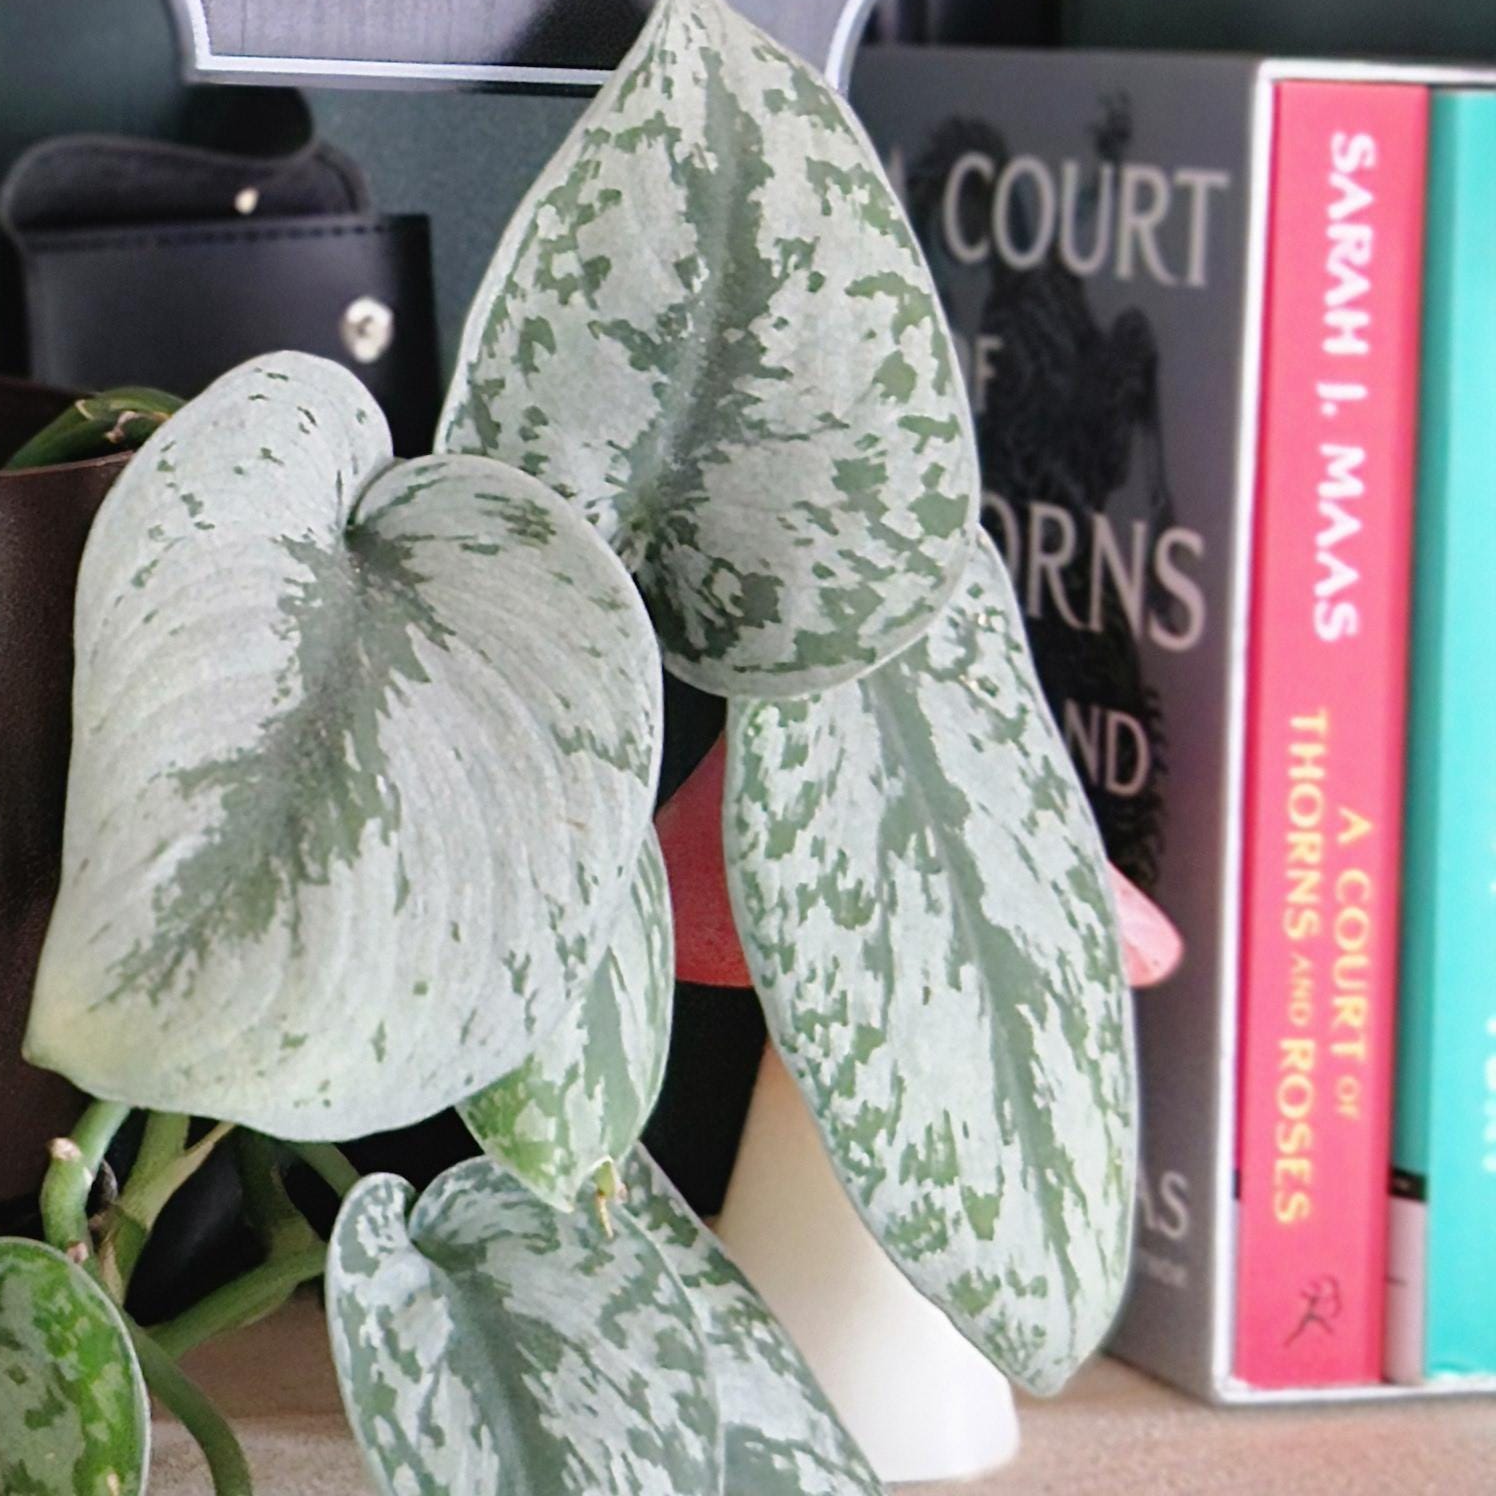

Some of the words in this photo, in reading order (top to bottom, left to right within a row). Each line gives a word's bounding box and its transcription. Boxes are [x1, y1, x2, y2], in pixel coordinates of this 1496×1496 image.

[941, 151, 1233, 289] COURT
[1320, 130, 1378, 357] SARAH
[1311, 441, 1368, 644] MAAS
[1065, 697, 1152, 797] ND
[1281, 707, 1331, 943] THORNS
[1334, 806, 1375, 847] A
[1328, 866, 1375, 1064] COURT
[1272, 1036, 1319, 1226] ROSES
